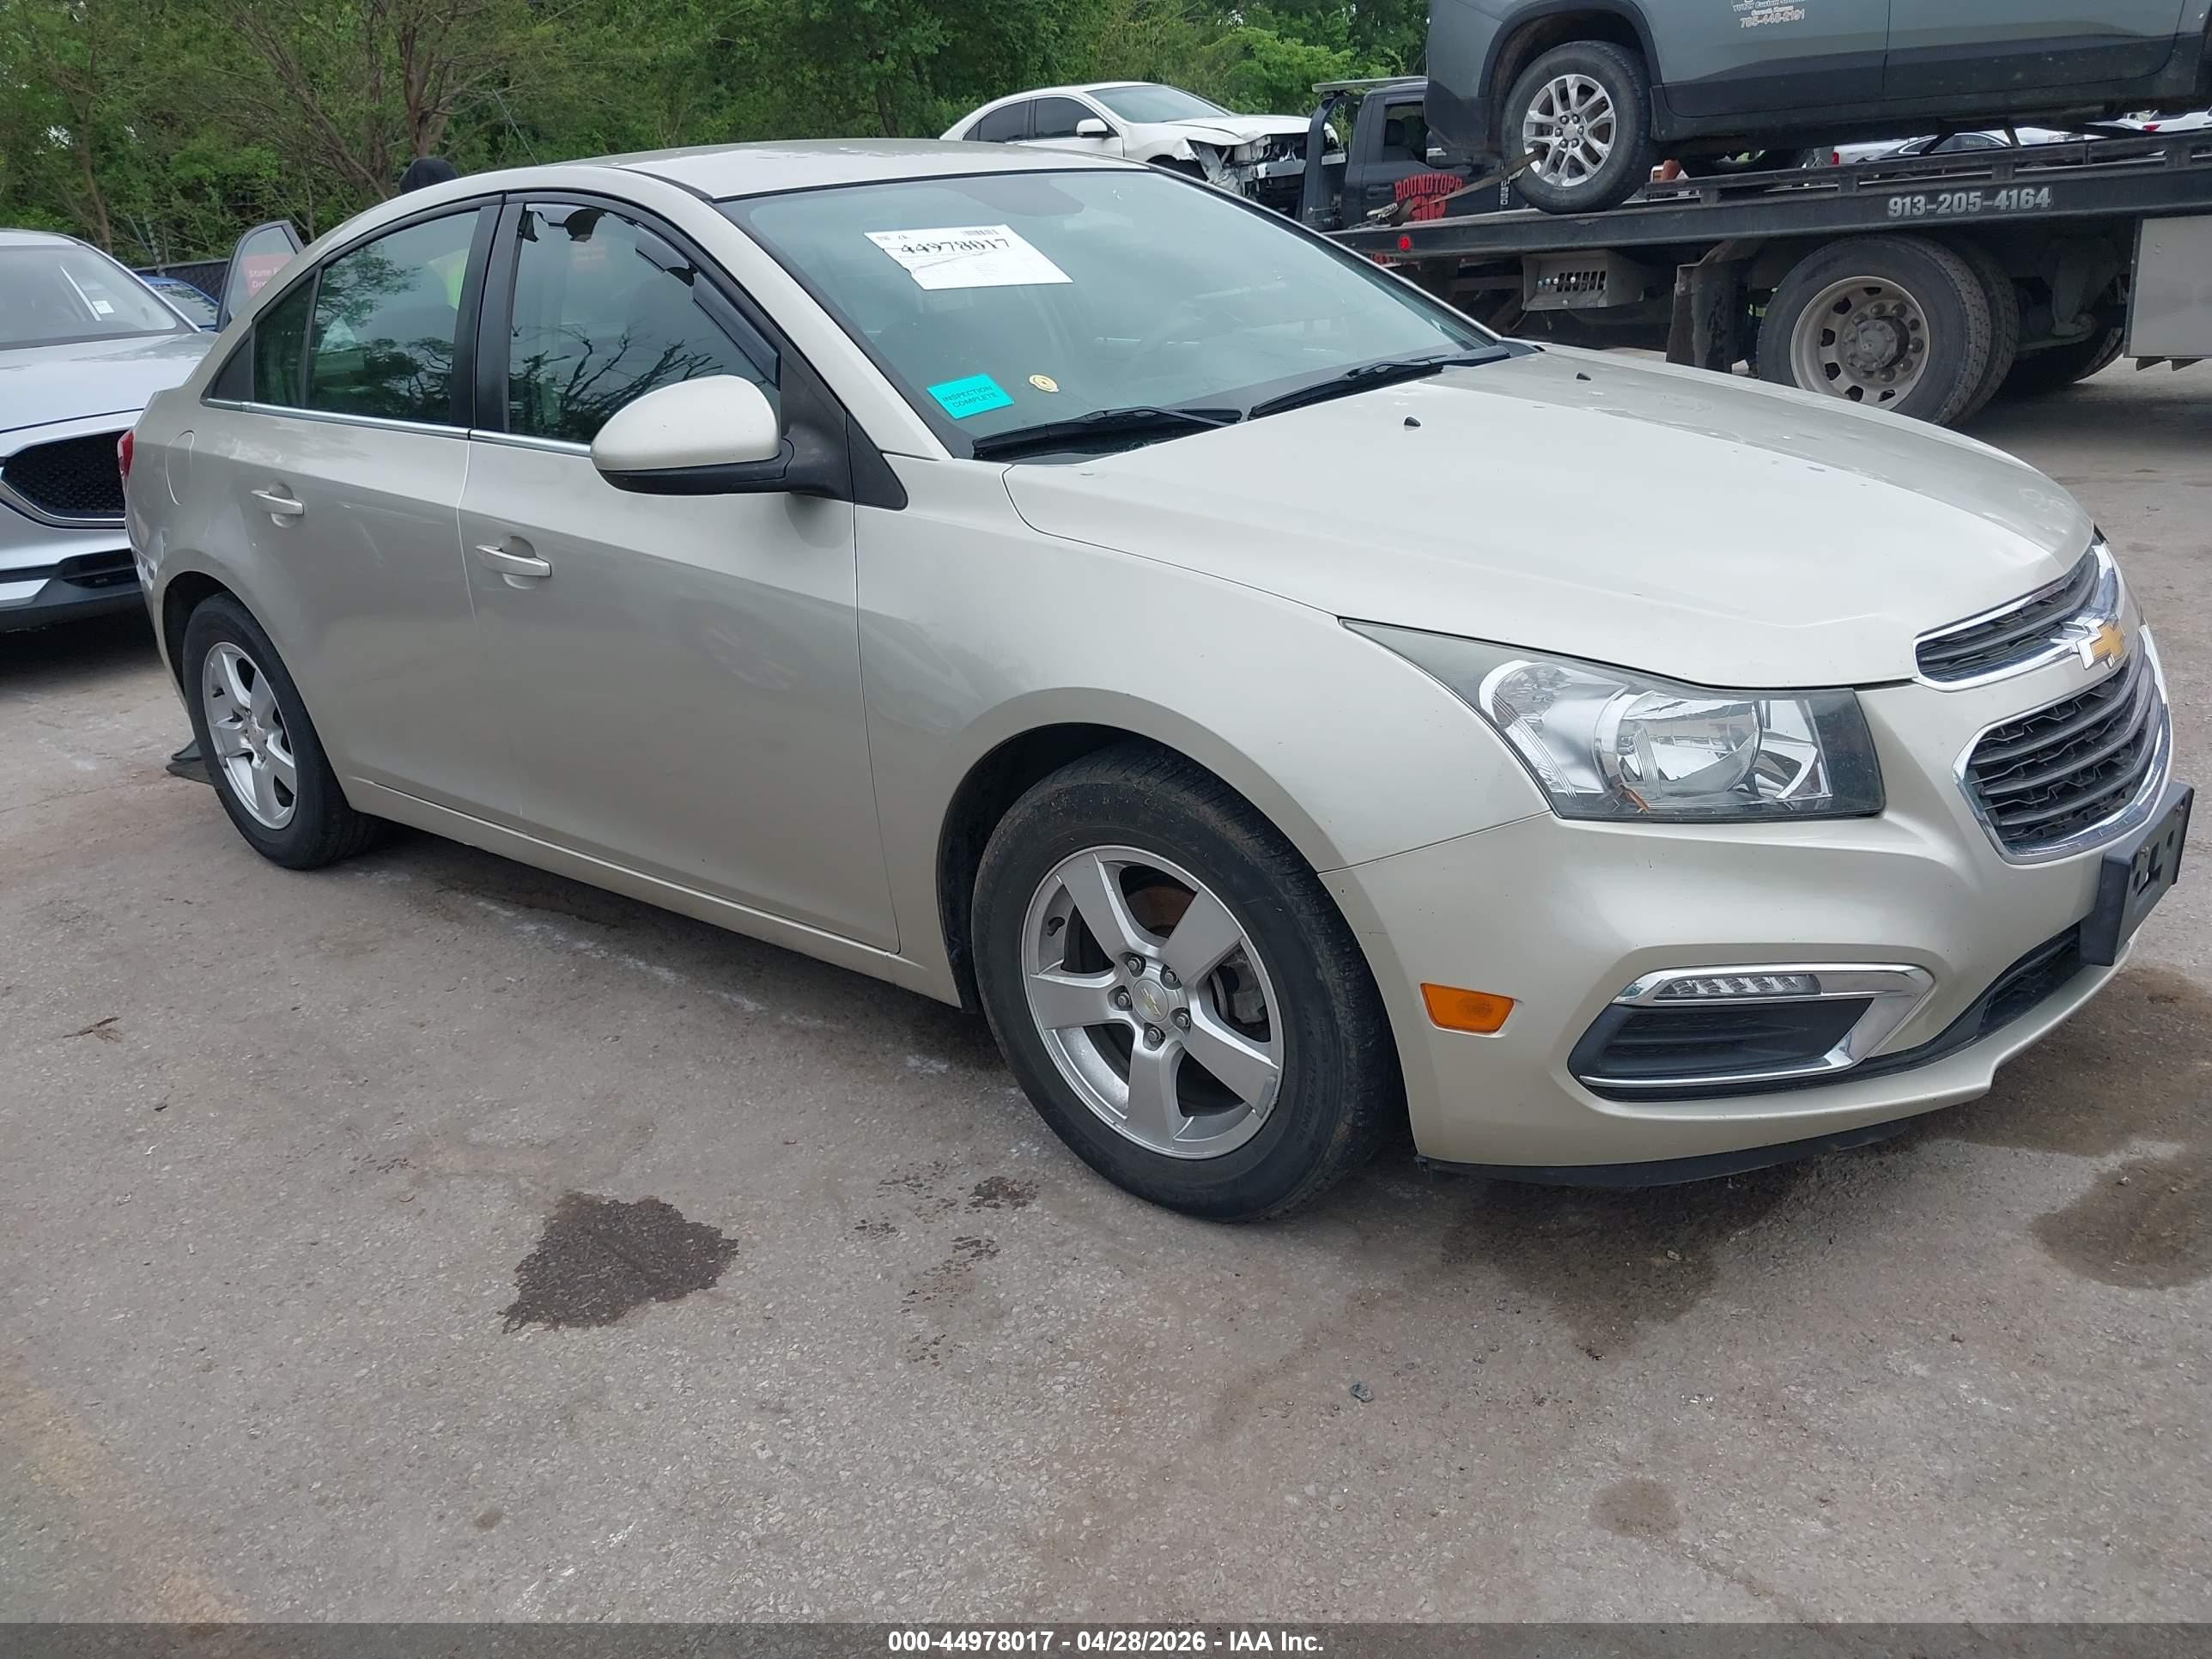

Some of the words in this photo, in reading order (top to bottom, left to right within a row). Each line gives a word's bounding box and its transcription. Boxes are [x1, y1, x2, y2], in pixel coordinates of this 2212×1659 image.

[1888, 187, 2051, 216] 913-205-4164
[902, 239, 1010, 254] 44978017
[942, 386, 993, 402] INSPECTION
[952, 392, 1000, 408] COMPLETE
